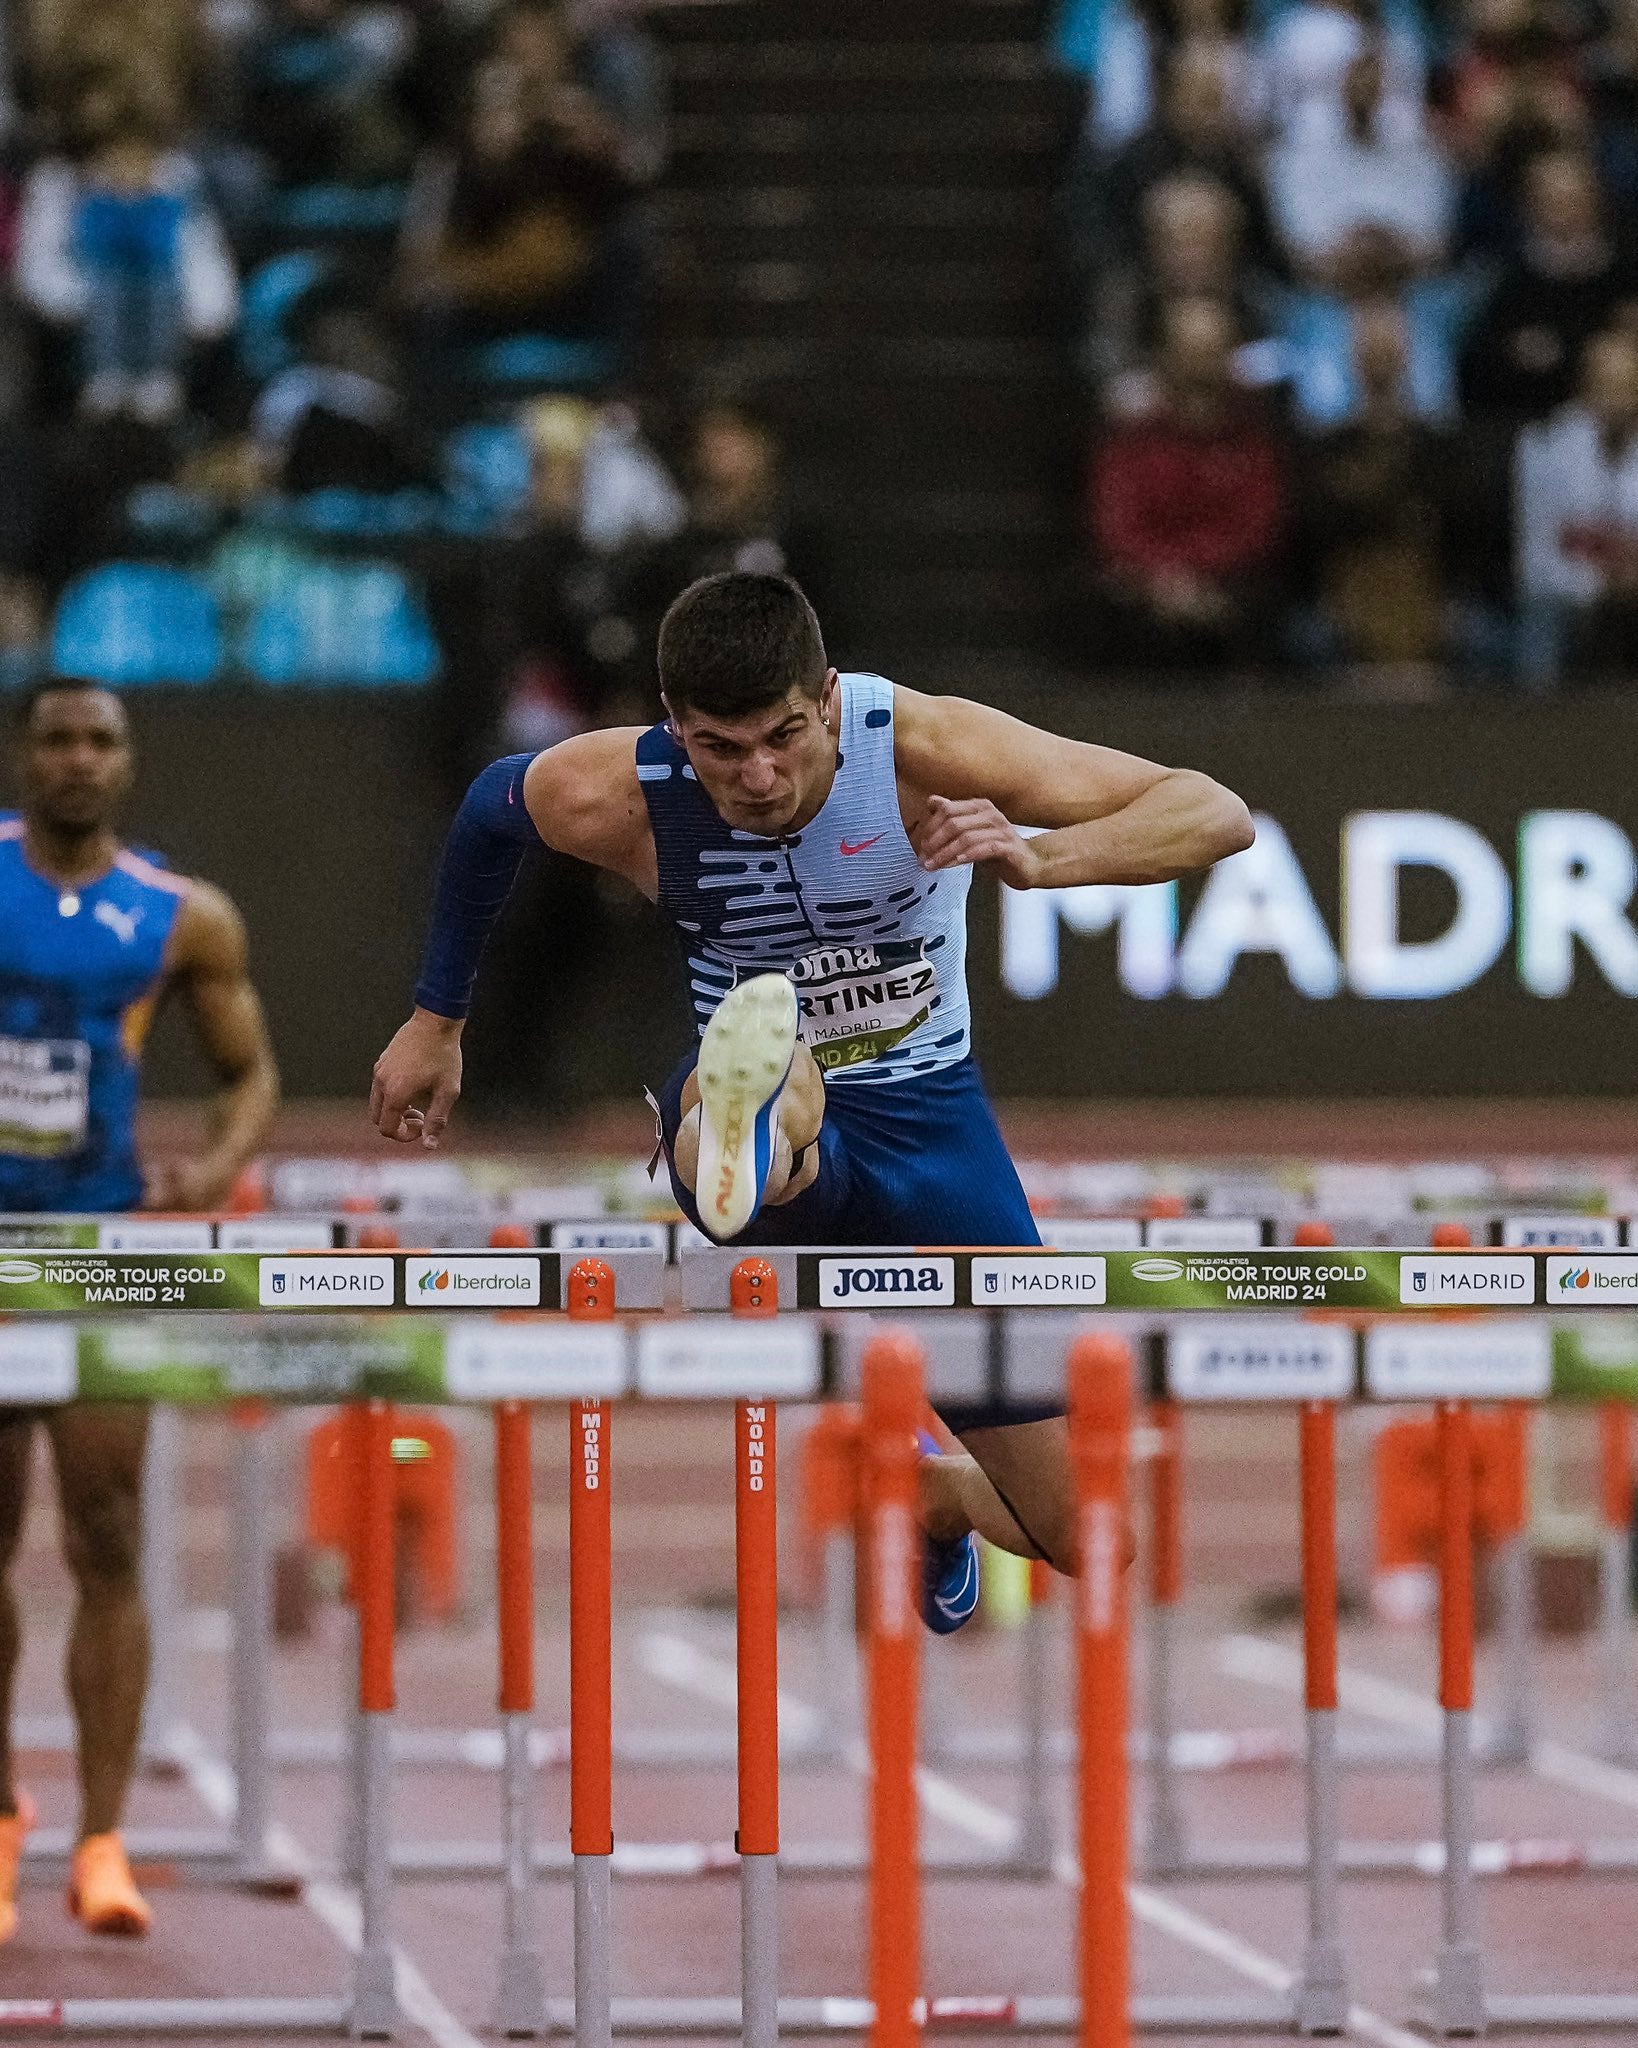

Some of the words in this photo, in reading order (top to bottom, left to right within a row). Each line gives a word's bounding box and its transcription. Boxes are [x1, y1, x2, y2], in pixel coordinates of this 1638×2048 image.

[815, 1018, 882, 1041] MADRID
[847, 1040, 878, 1062] 24
[45, 1268, 116, 1283] INDOOR
[120, 1268, 170, 1283] TOUR
[174, 1268, 226, 1283] GOLD
[453, 1273, 531, 1289] Iberdrola
[1012, 1274, 1097, 1290] MADRID
[1186, 1266, 1258, 1282] INDOOR
[1261, 1266, 1311, 1282] TOUR
[1314, 1266, 1367, 1282] GOLD
[1440, 1273, 1525, 1289] MADRID
[300, 1275, 385, 1291] MADRID
[85, 1287, 157, 1302] MADRID
[161, 1287, 186, 1302] 24
[1226, 1284, 1298, 1300] MADRID
[1302, 1284, 1327, 1300] 24
[581, 1413, 601, 1490] MONDO
[746, 1407, 766, 1491] MONDO
